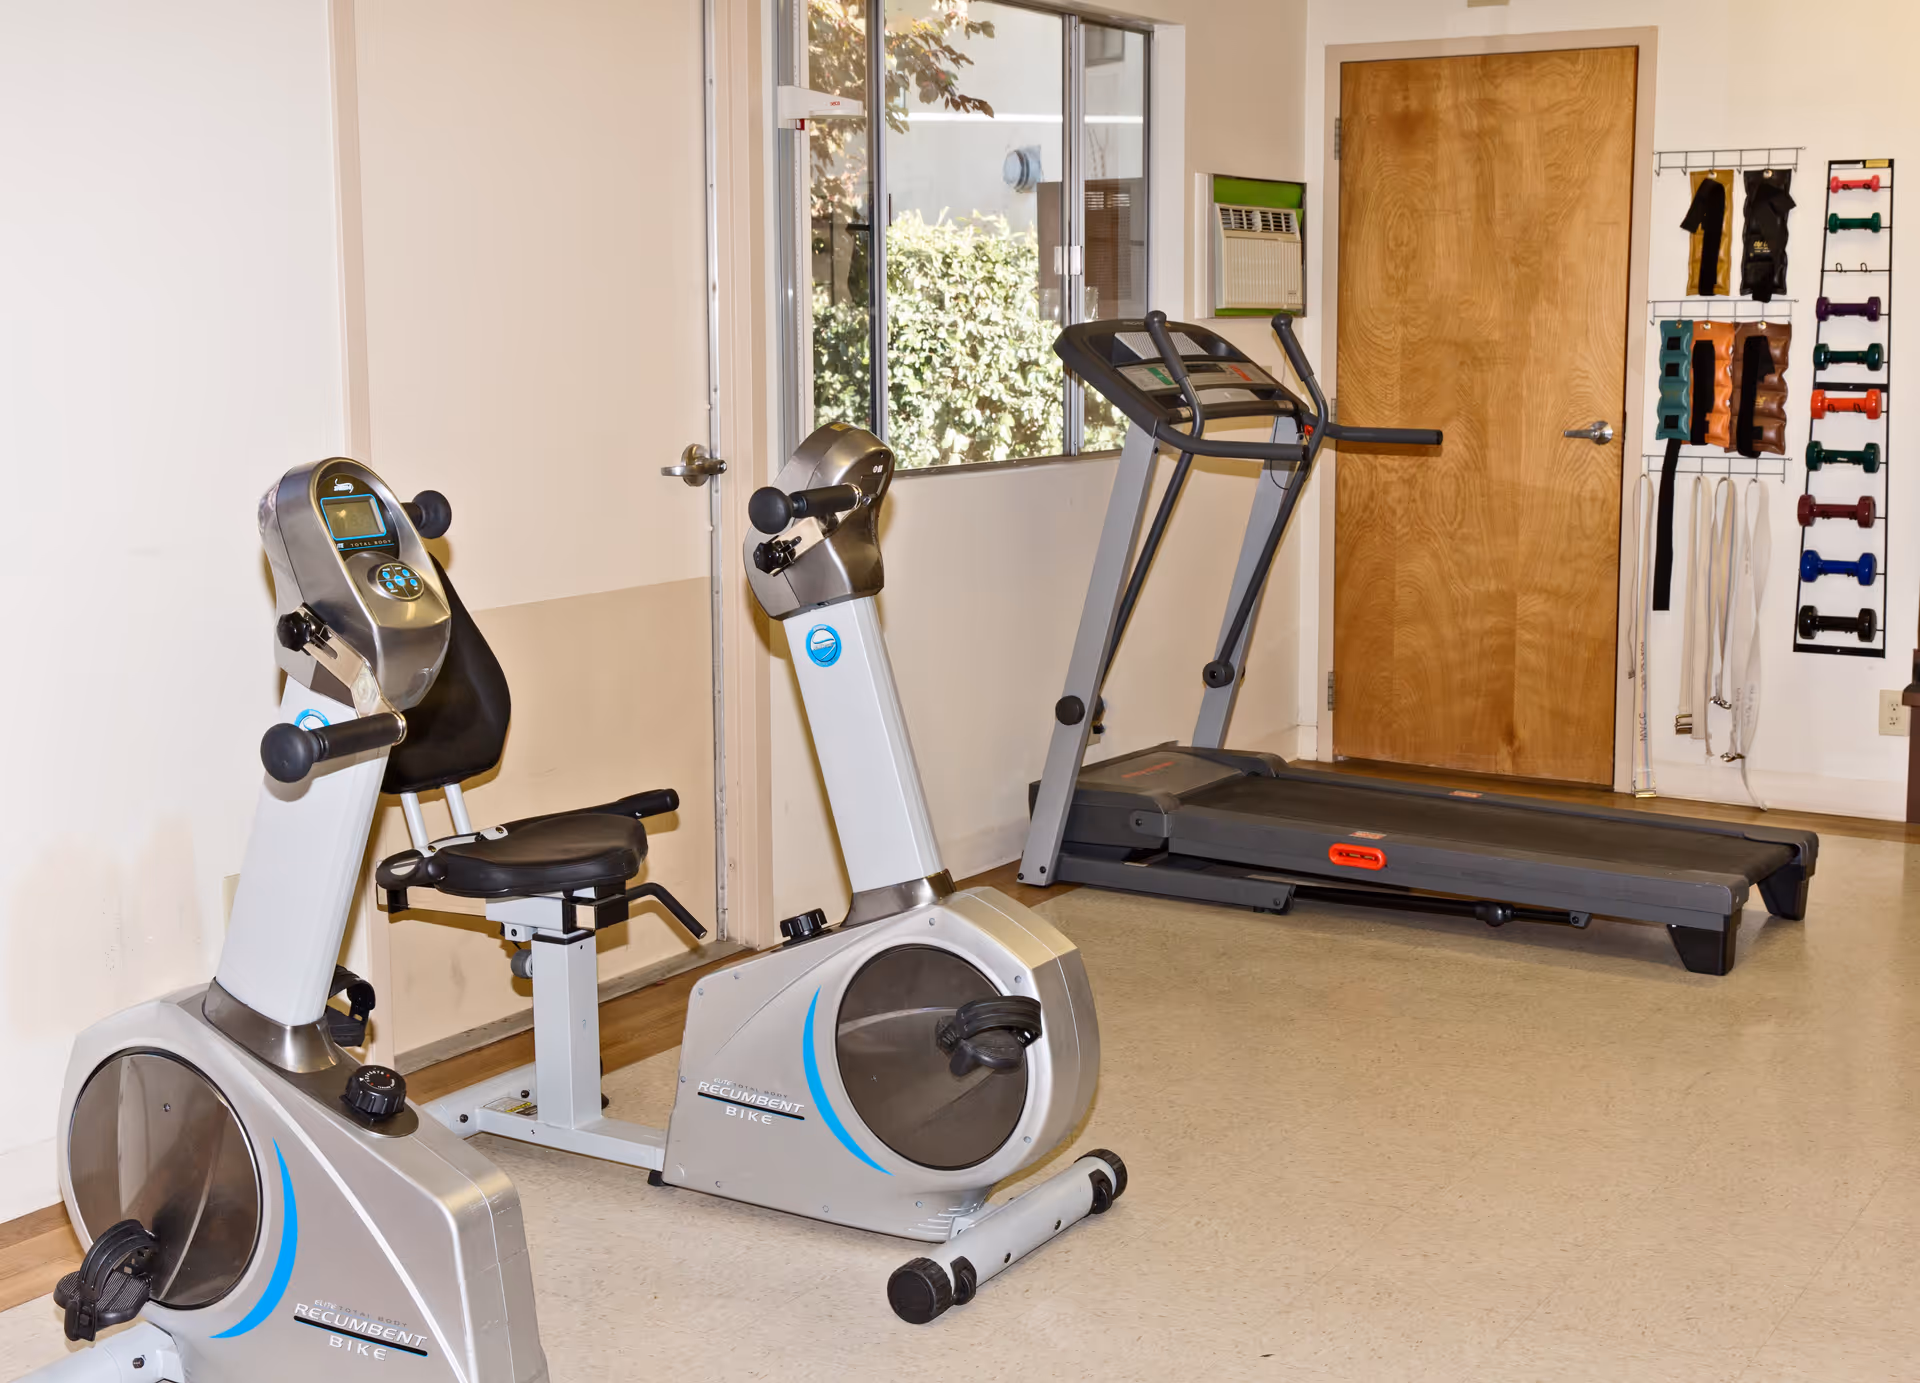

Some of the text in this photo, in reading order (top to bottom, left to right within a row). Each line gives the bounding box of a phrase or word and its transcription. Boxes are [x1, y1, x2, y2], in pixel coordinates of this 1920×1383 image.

[698, 1081, 805, 1114] RECUMBENT
[732, 1082, 759, 1093] TOTAL
[763, 1090, 789, 1099] BODY
[725, 1105, 773, 1125] BIKE
[294, 1302, 428, 1347] RECUMBENT
[338, 1305, 371, 1319] TOTAL
[377, 1316, 408, 1328] BODY
[328, 1334, 388, 1361] BIKE
